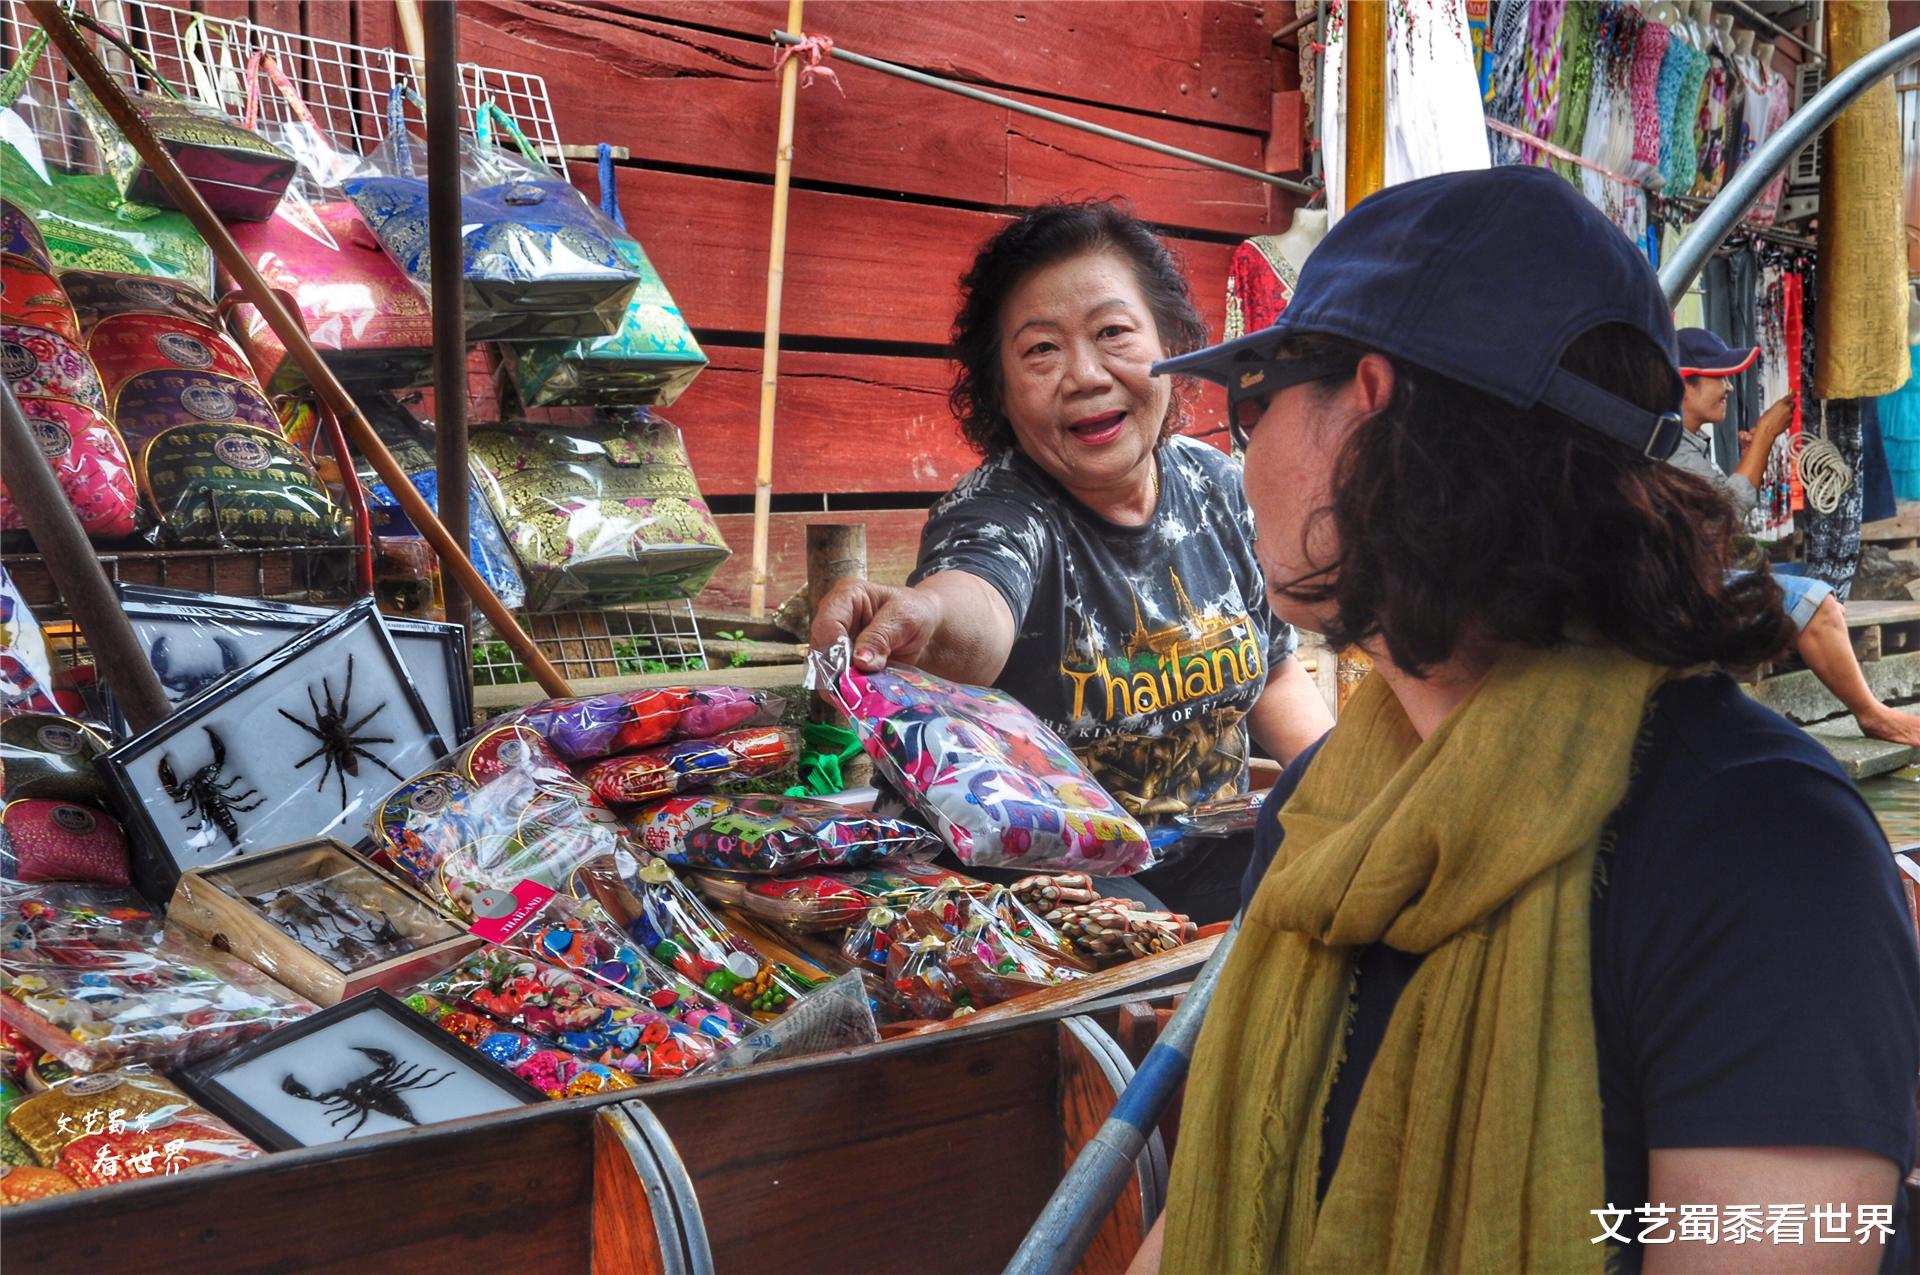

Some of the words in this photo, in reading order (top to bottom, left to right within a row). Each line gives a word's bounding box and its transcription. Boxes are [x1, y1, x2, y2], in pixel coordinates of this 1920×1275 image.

[1060, 617, 1264, 721] Thailand
[1042, 719, 1068, 735] HE
[1080, 715, 1163, 738] KINGDOM
[1172, 706, 1193, 722] OF
[501, 896, 543, 933] THAILAND
